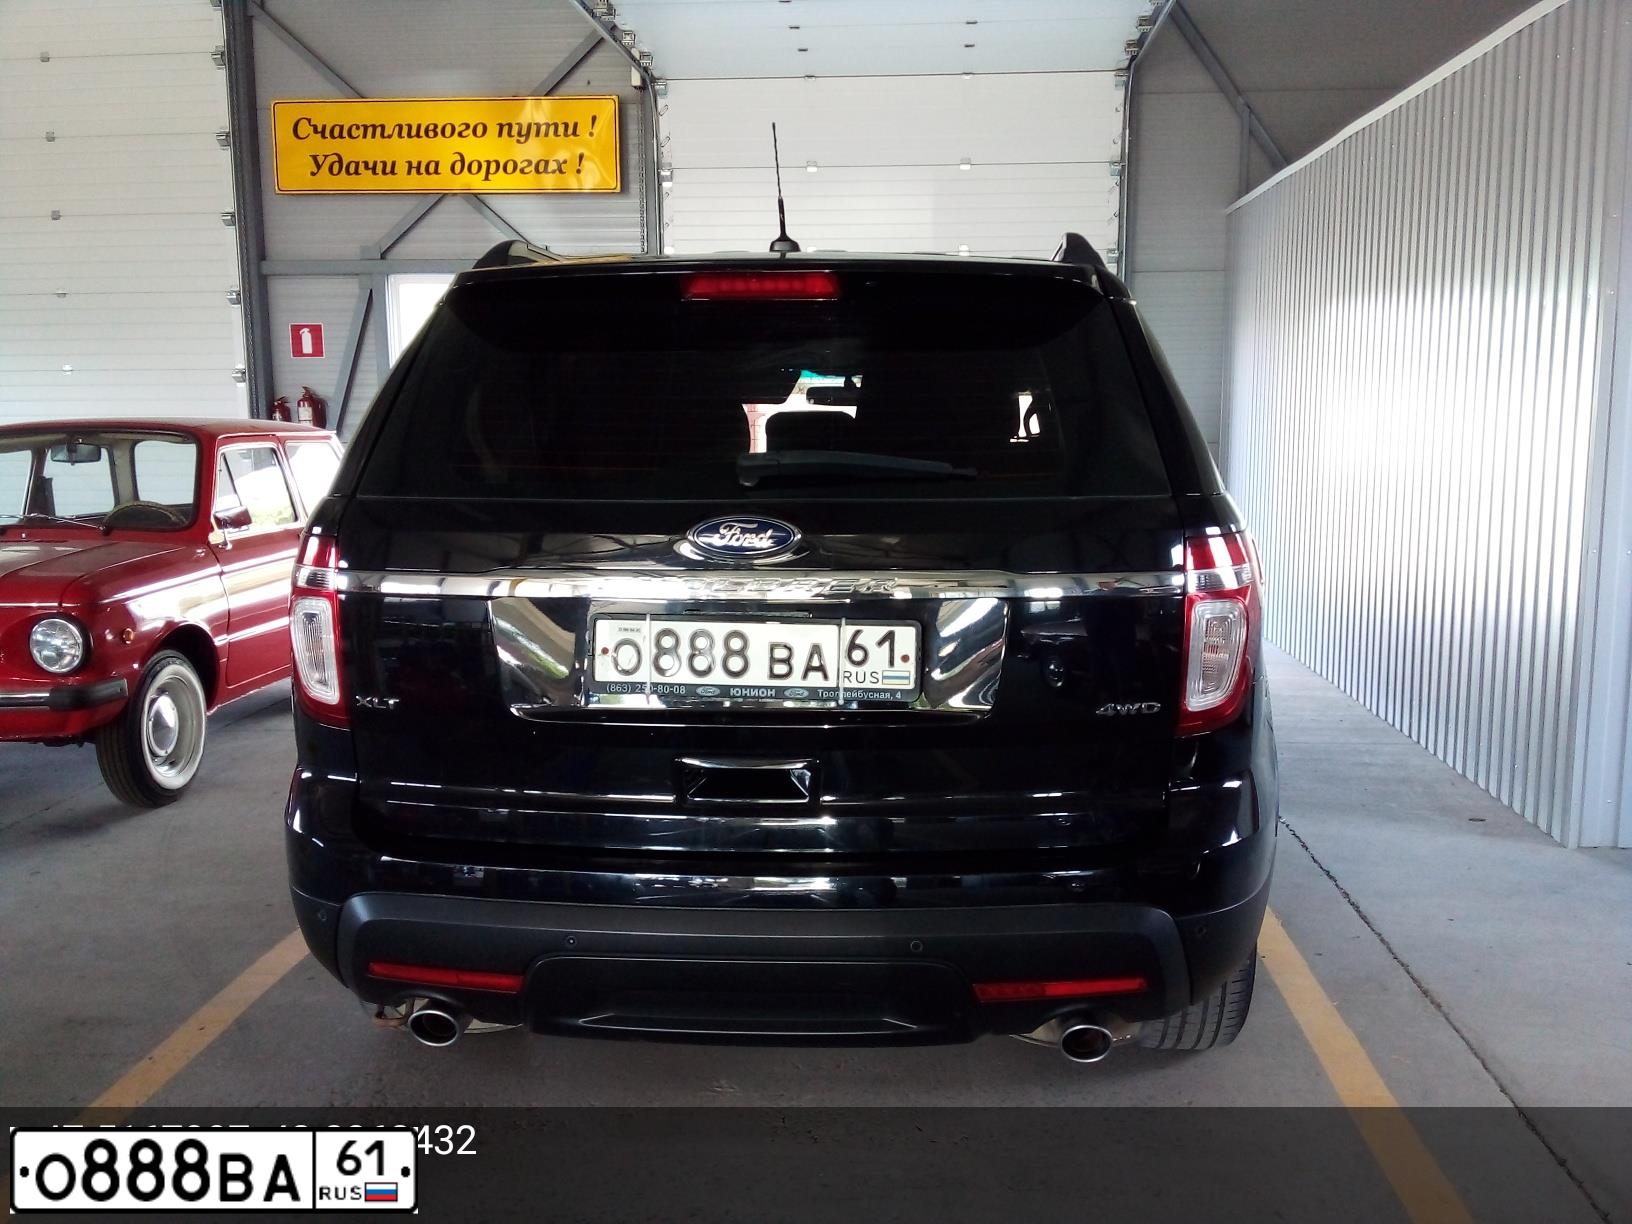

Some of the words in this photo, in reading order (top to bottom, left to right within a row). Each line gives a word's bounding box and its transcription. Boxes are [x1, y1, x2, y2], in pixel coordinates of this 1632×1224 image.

[292, 116, 488, 140] Счастливого
[496, 121, 580, 145] пути
[309, 152, 398, 177] Удачи
[405, 159, 441, 176] на
[450, 151, 568, 182] дорогах
[703, 521, 778, 548] Ford
[846, 628, 896, 668] 61
[843, 670, 880, 684] RUS
[606, 683, 632, 693] (863)
[730, 688, 776, 697] ЮНИОН
[355, 695, 400, 710] XLT
[1095, 702, 1161, 716] 4WD
